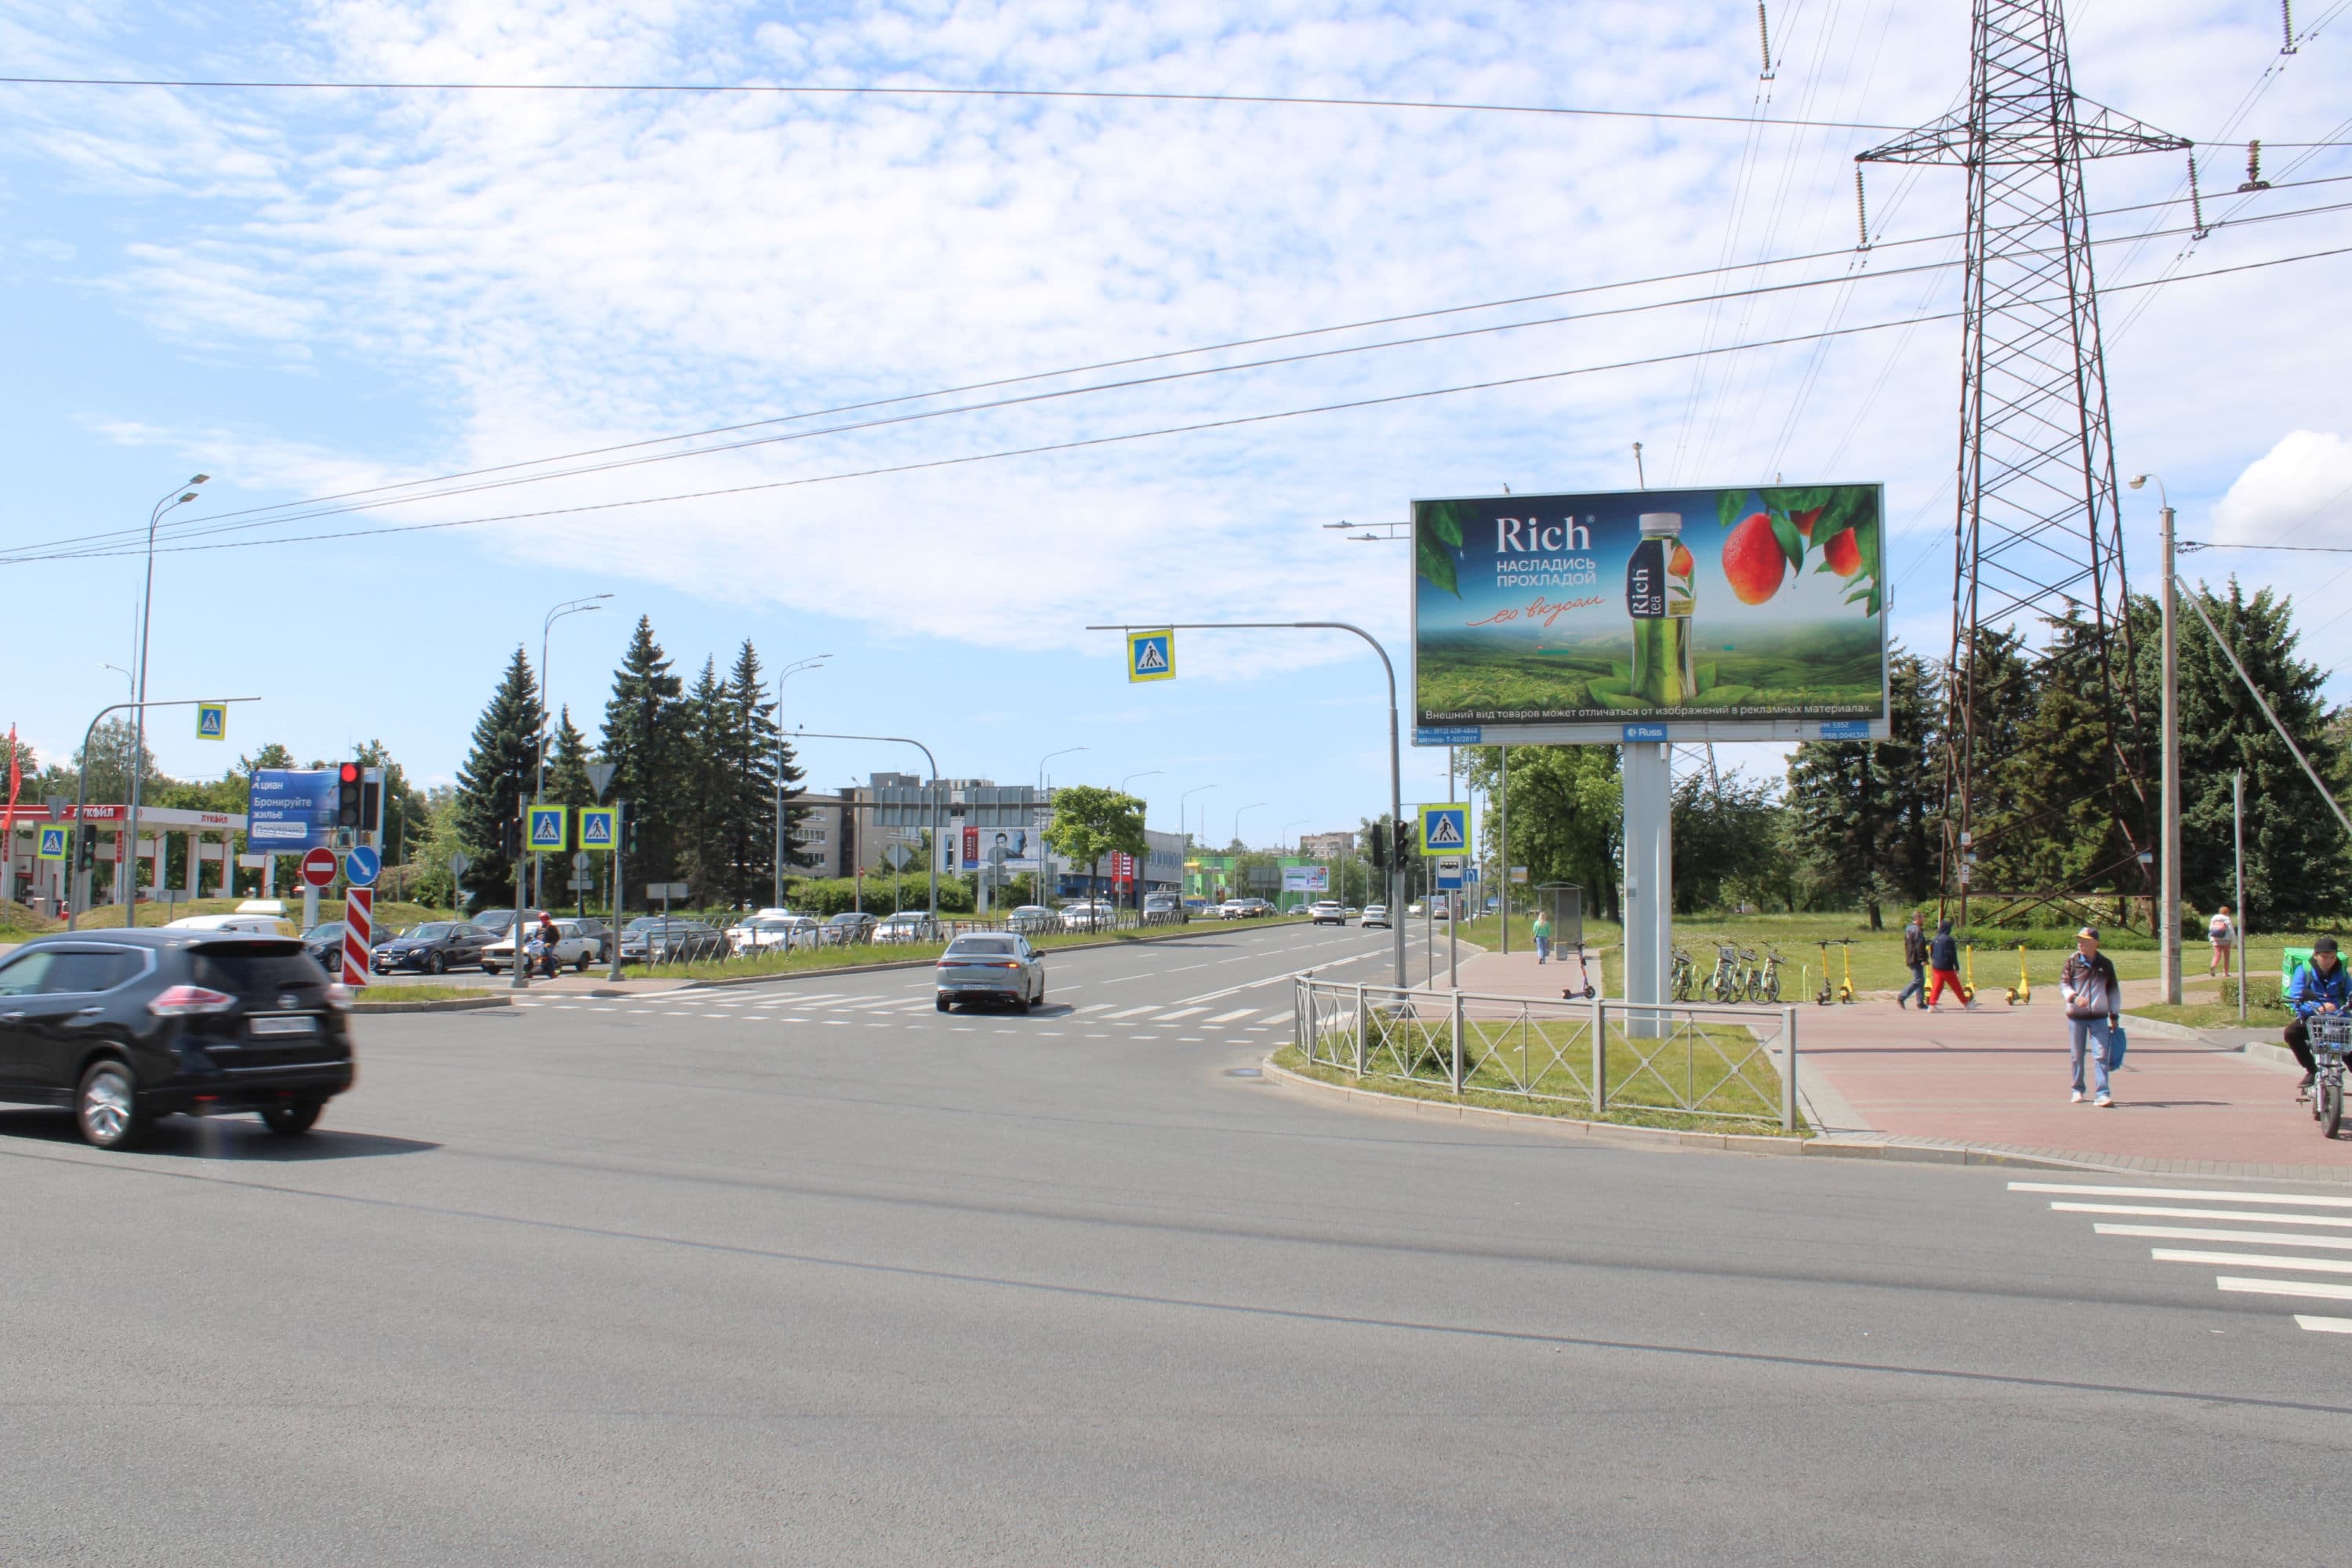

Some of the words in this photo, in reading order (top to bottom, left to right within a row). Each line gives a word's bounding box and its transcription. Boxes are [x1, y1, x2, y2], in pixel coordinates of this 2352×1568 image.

[1496, 557, 1596, 573] НАСЛАДИСЬ
[1497, 570, 1597, 587] ПРОХЛАДОЙ
[1632, 568, 1649, 615] Rich
[1526, 594, 1606, 627] вкусом
[1650, 595, 1661, 615] tea
[1425, 710, 1474, 720] Внешний
[1475, 710, 1496, 720] вид
[1497, 710, 1541, 720] товаров
[1542, 709, 1575, 718] может
[1578, 708, 1639, 717] отличаться
[1641, 707, 1653, 716] от
[1655, 705, 1730, 717] изображений
[1740, 707, 1801, 716] рекламных
[1804, 705, 1874, 715] материалах.
[1639, 727, 1663, 737] Russ
[260, 782, 284, 790] циан
[253, 797, 313, 808] Бронируйте
[201, 814, 228, 824] ЛУКОЙЛ
[252, 811, 284, 819] жилье
